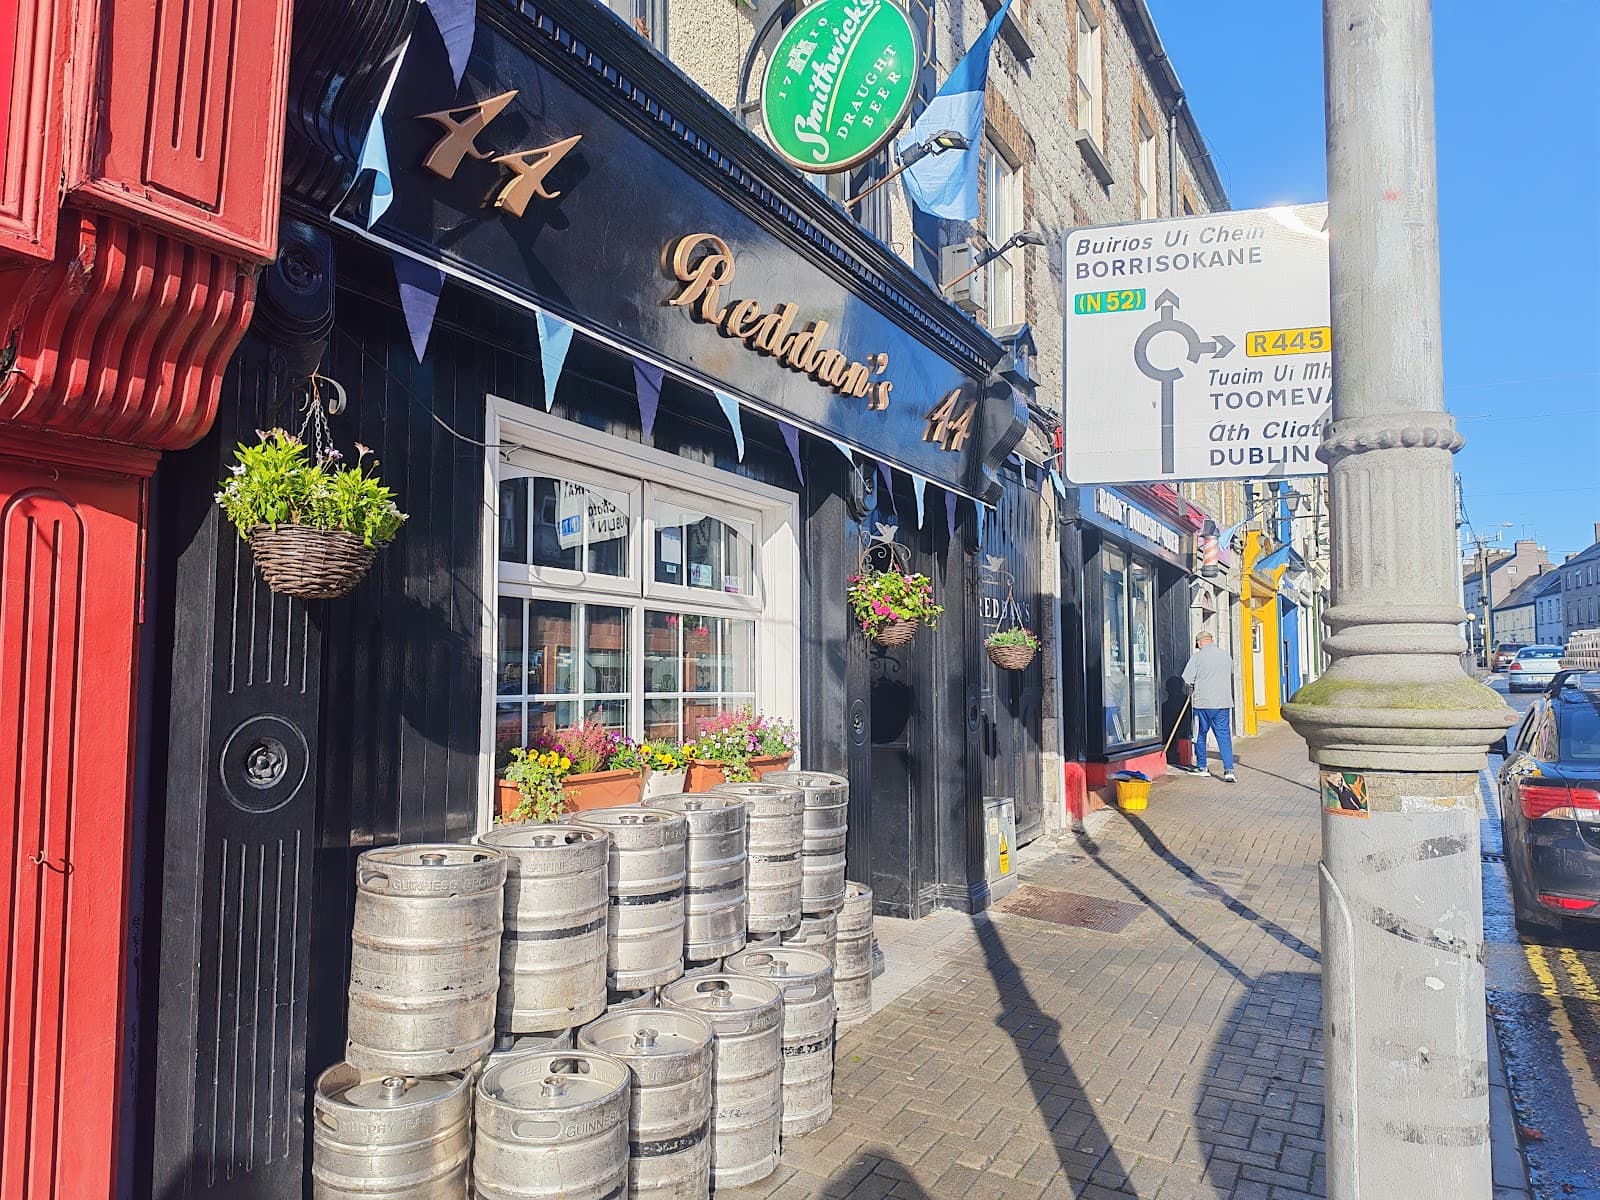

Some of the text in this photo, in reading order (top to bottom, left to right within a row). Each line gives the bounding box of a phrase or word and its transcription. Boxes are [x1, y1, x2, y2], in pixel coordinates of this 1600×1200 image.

[836, 44, 897, 140] DRAUGHT
[861, 71, 902, 128] BEER
[1076, 246, 1262, 280] BORRISOKANE
[660, 232, 894, 412] Reddan's
[1208, 367, 1263, 387] Tuaim
[1209, 444, 1310, 467] DUBLIN
